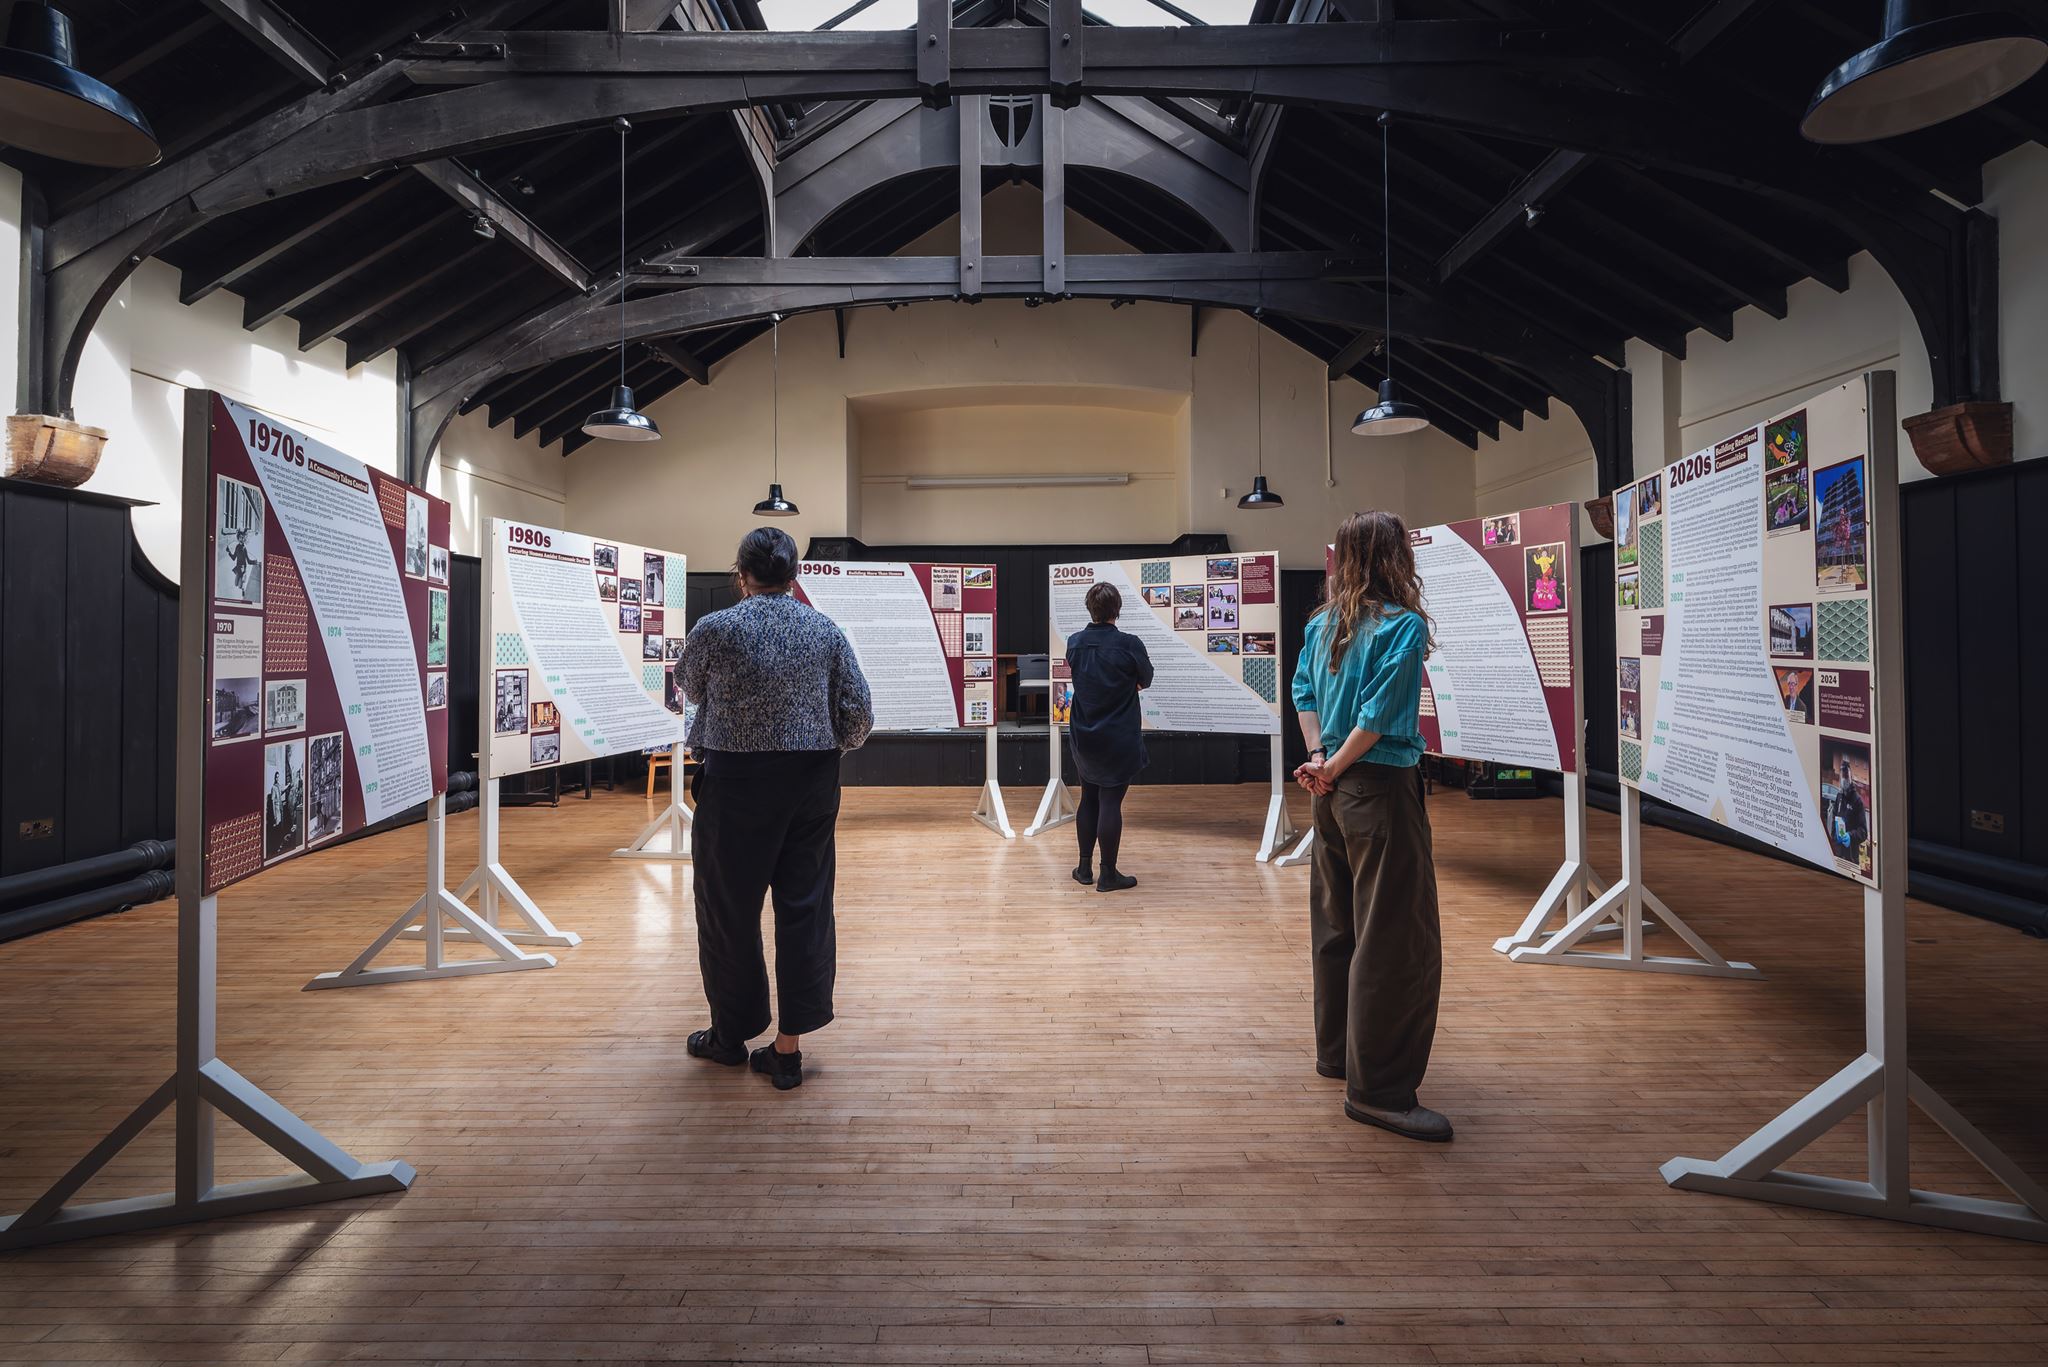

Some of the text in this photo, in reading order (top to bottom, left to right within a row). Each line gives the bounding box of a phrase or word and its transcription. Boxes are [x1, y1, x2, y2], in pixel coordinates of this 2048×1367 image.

[249, 419, 304, 467] 1970s
[1716, 432, 1756, 456] Building Resilient
[1716, 452, 1746, 469] Communities
[314, 465, 340, 482] Community
[340, 474, 352, 486] Takes
[352, 478, 368, 492] Control
[1670, 455, 1711, 488] 2020s
[509, 526, 551, 548] 1980s
[1054, 567, 1094, 578] 2000s
[1670, 592, 1683, 602] 2022
[217, 622, 232, 632] 1970
[328, 626, 341, 637] 1974
[1660, 681, 1672, 690] 2023
[1821, 675, 1836, 684] 2024
[348, 704, 361, 715] 1976
[1657, 720, 1670, 730] 2024
[359, 745, 372, 756] 1978
[1725, 752, 1734, 762] This
[1735, 757, 1760, 769] anniversary
[1762, 764, 1782, 774] provides
[1726, 762, 1752, 776] opportunity
[1759, 772, 1774, 781] reflect
[366, 782, 378, 793] 1979
[1727, 771, 1750, 783] remarkable
[1770, 782, 1776, 792] 50
[1777, 786, 1790, 796] years
[1730, 788, 1744, 798] rooted
[1745, 792, 1750, 800] in
[1760, 799, 1788, 814] community
[1789, 807, 1802, 818] from
[1736, 780, 1751, 792] Queens
[1752, 786, 1764, 796] Cross
[1765, 790, 1780, 803] Group
[1781, 797, 1802, 809] remains
[1732, 797, 1746, 807] which
[1798, 820, 1804, 828] to
[1735, 807, 1804, 838] provide excellent housing in
[1738, 816, 1788, 841] vibrant communities.
